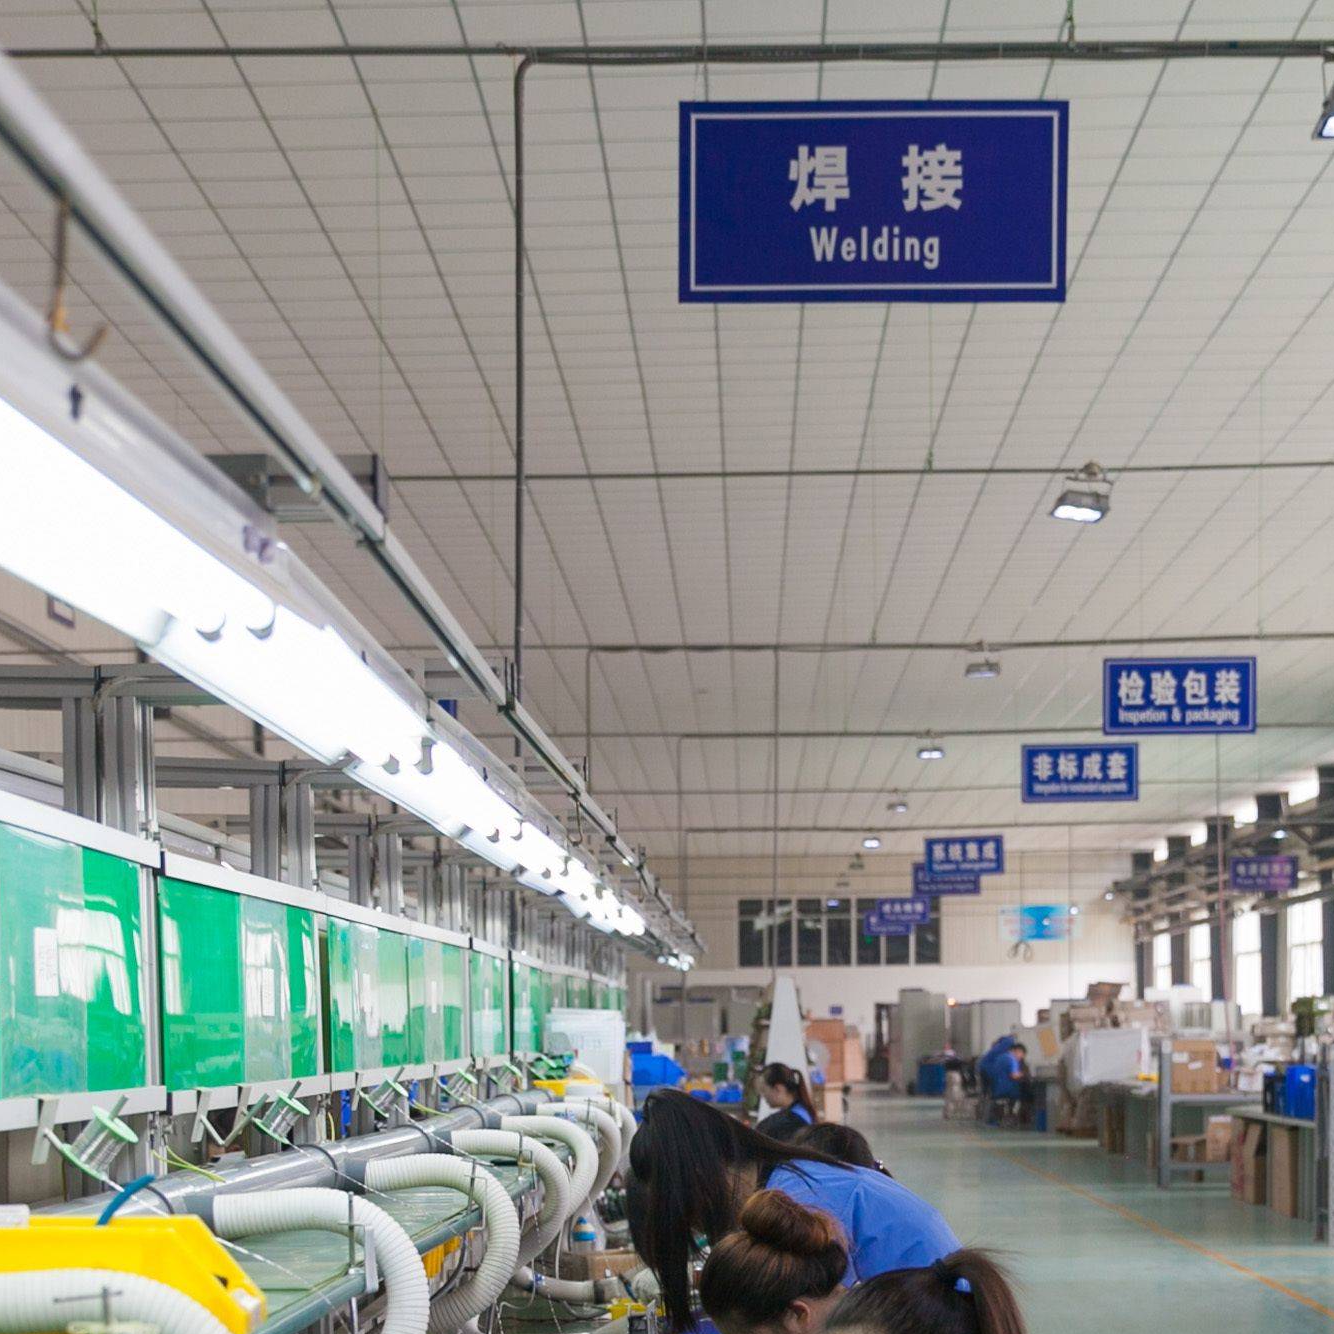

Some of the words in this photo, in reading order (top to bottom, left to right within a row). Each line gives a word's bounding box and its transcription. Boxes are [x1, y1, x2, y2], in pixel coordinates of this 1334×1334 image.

[788, 142, 964, 212] 焊接
[810, 225, 941, 270] Welding
[1118, 668, 1242, 706] 检验包装
